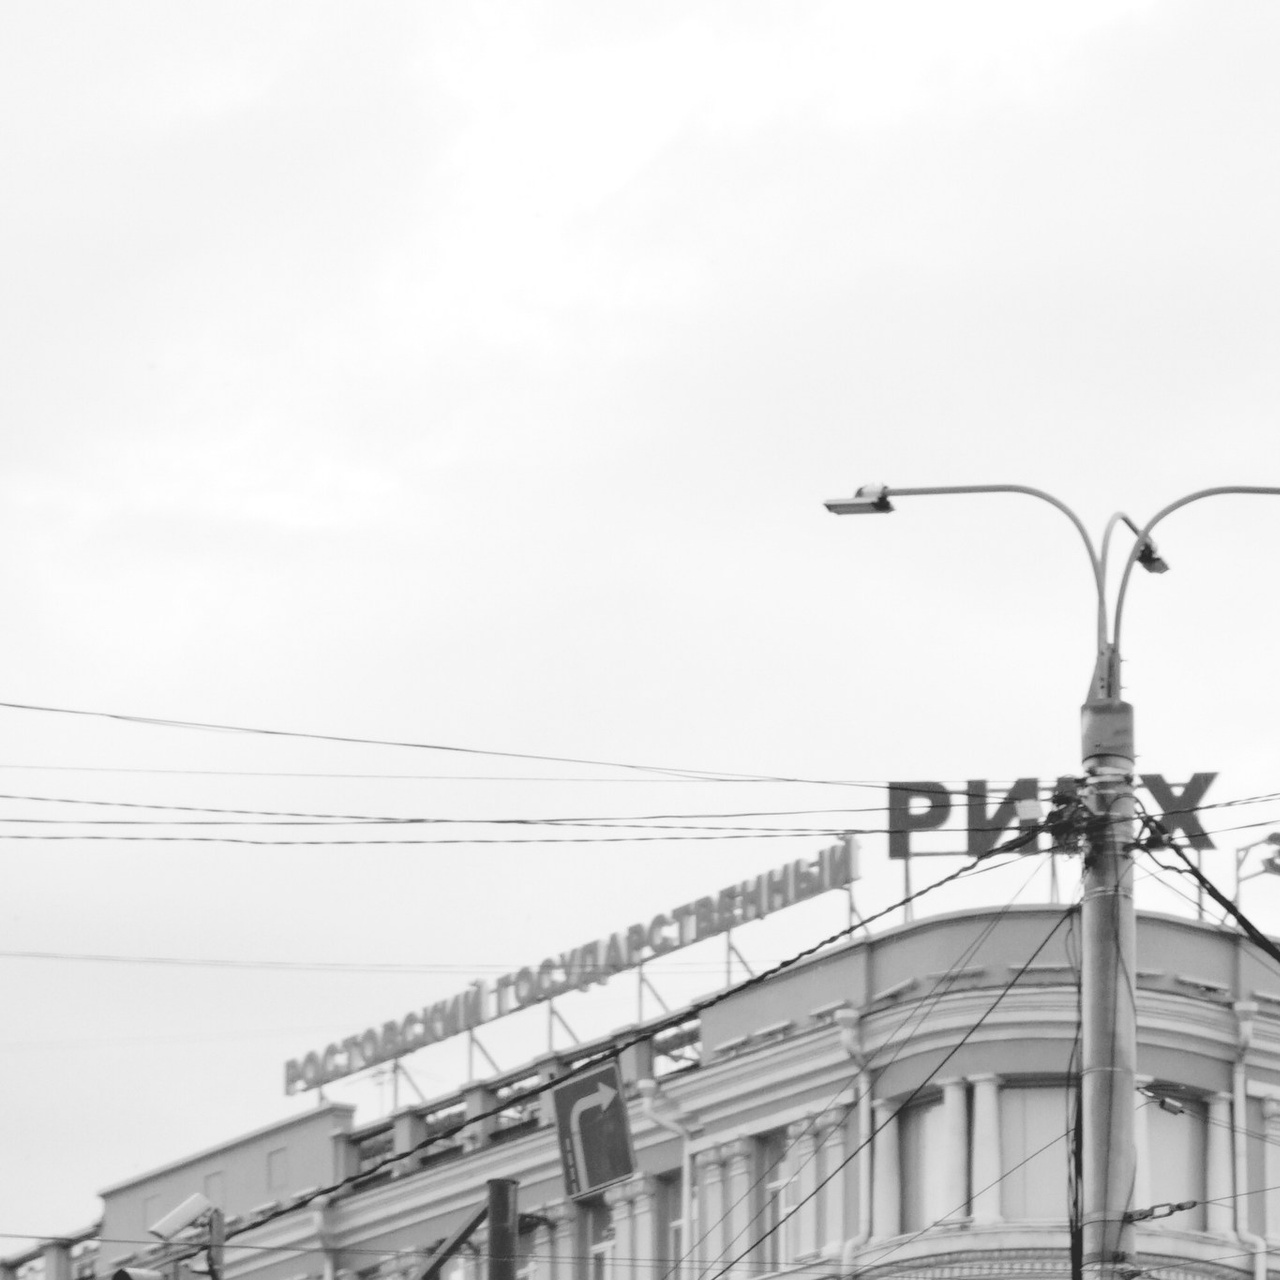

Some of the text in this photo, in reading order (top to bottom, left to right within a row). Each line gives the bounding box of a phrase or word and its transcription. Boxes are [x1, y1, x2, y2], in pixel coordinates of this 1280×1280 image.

[888, 772, 1220, 860] РИХ
[285, 831, 859, 1096] РОСТОВСКИЙ ГОСУДАРСТВЕННЫЙ
